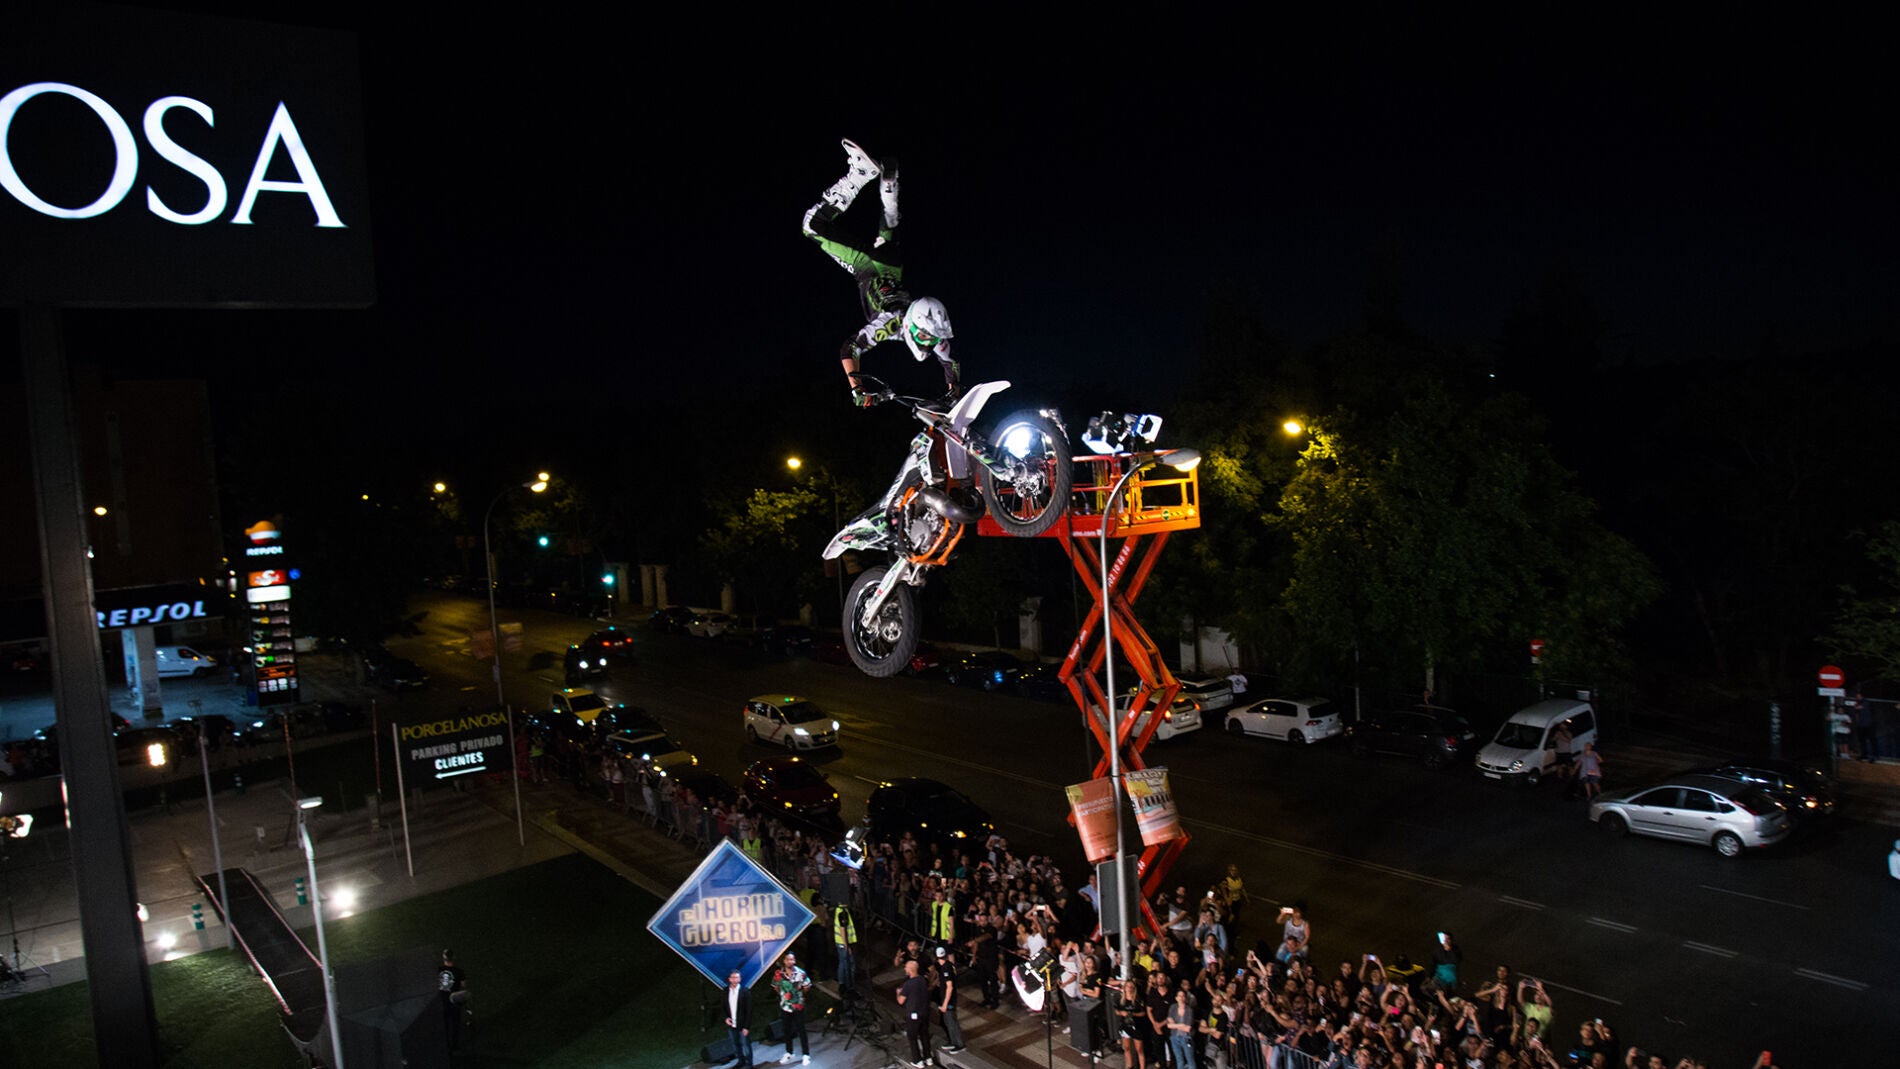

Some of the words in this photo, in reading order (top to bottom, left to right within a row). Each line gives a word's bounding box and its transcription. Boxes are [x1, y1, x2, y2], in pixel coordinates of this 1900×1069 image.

[0, 81, 349, 228] OSA
[402, 713, 507, 740] PORCELANOSA
[412, 744, 457, 760] PARKING
[461, 735, 503, 751] PRIVADO
[435, 752, 484, 770] CLIENTES
